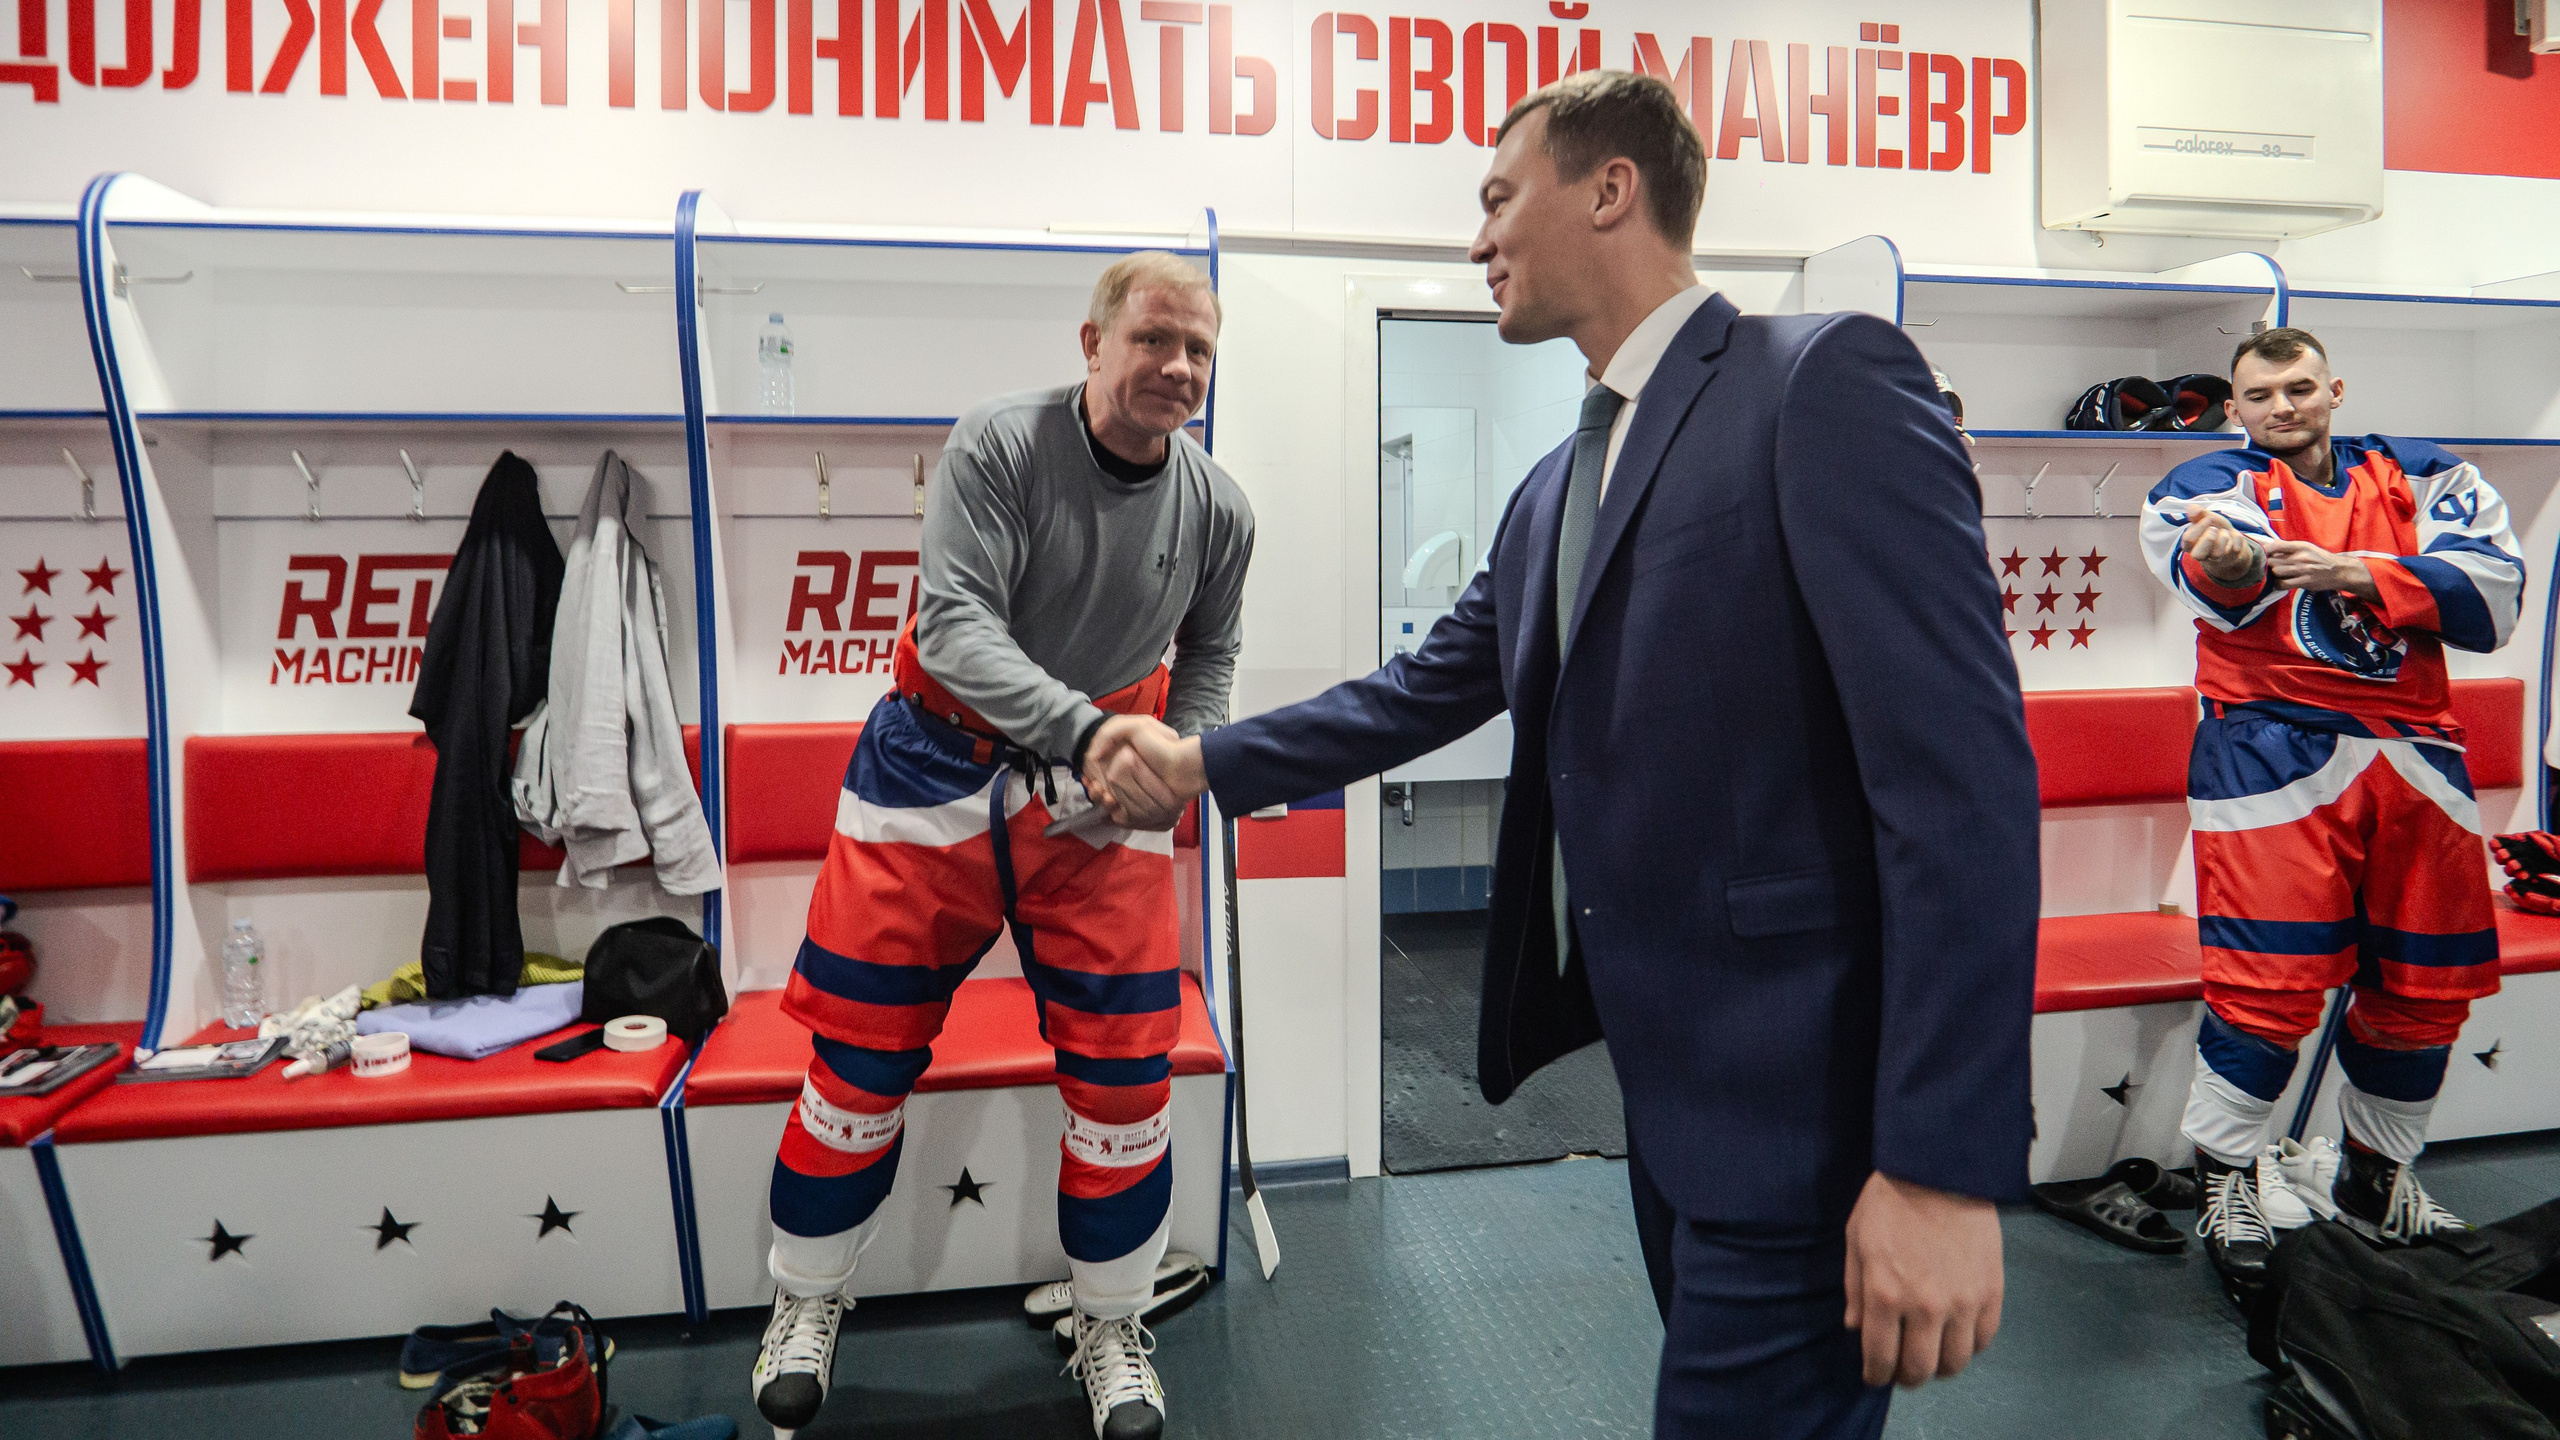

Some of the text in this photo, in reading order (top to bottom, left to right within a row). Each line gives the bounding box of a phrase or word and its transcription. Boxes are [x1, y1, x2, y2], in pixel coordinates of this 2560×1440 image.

[609, 0, 1277, 136] ПОНИМАТЬ
[2175, 134, 2282, 157] calorex 33
[786, 550, 920, 632] RE
